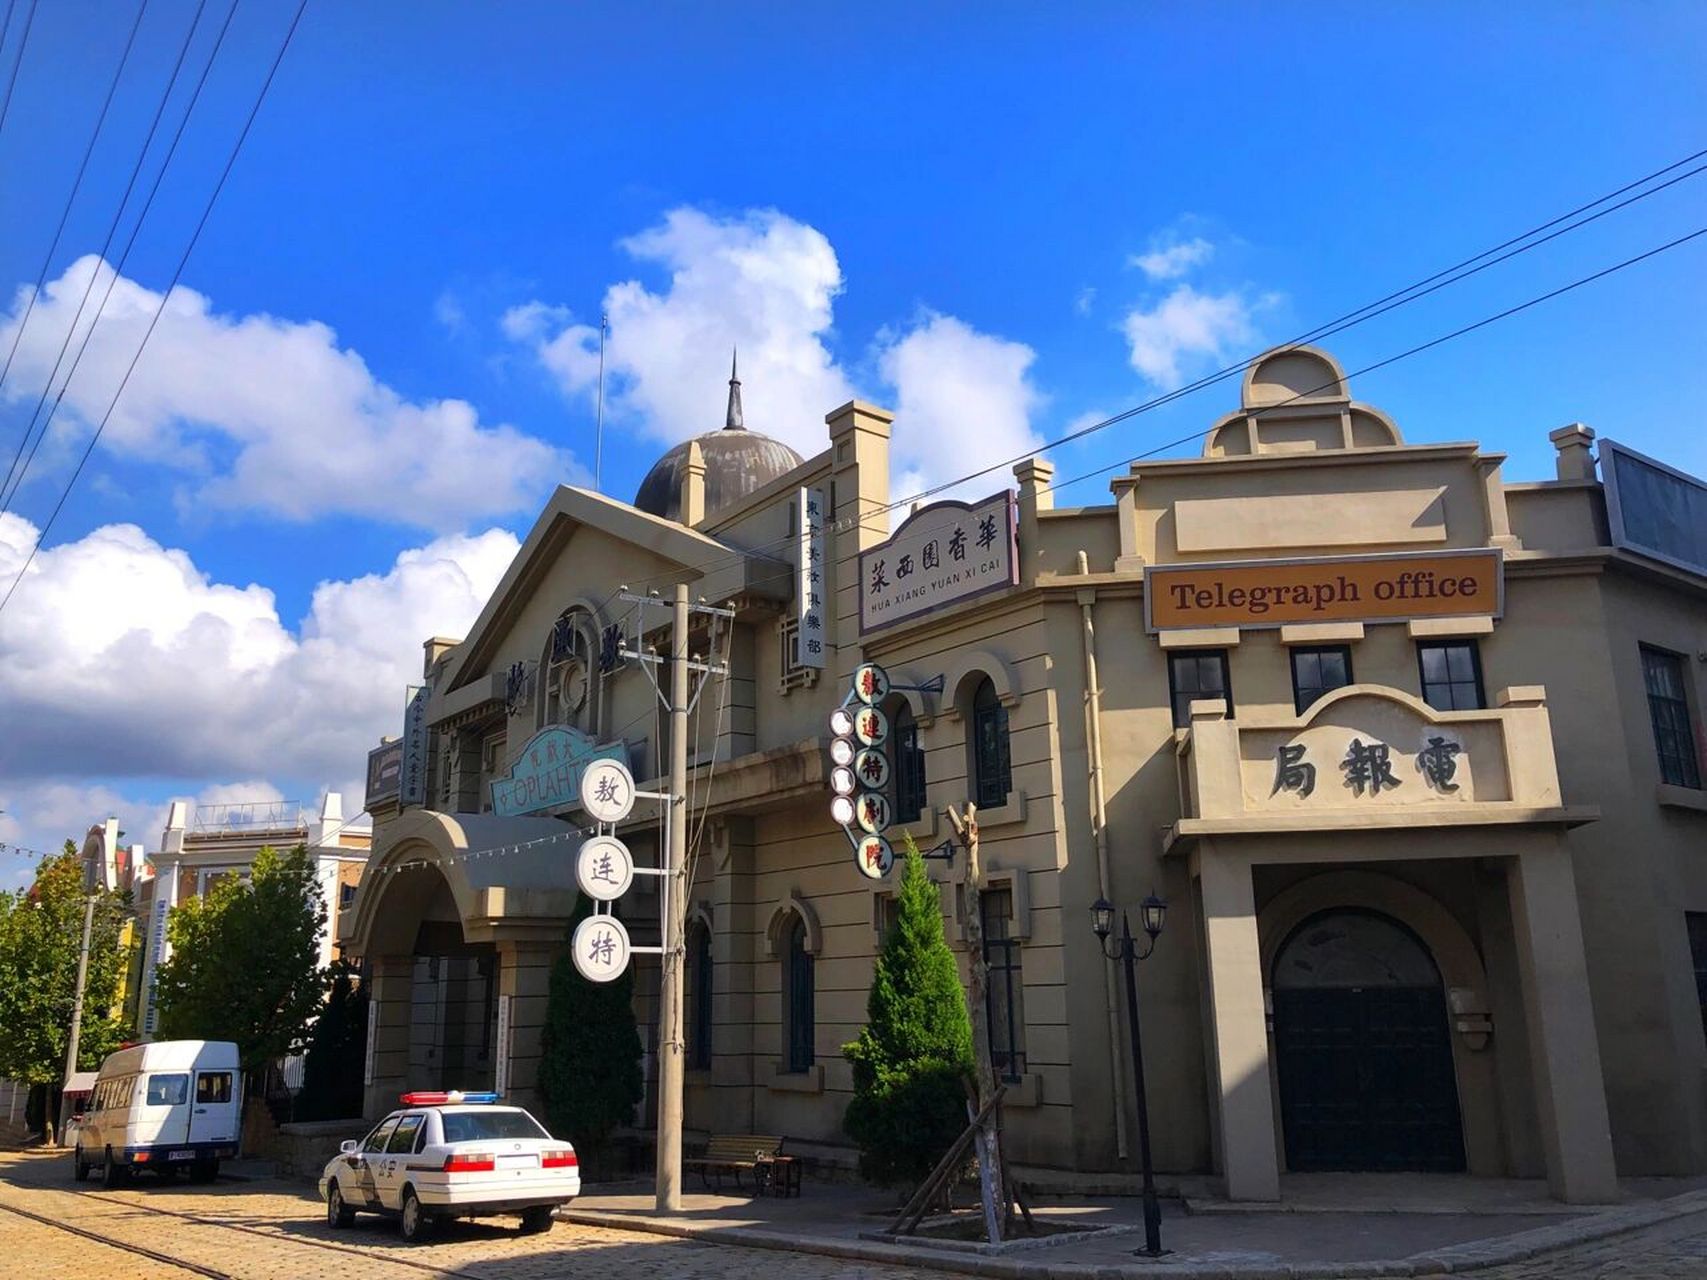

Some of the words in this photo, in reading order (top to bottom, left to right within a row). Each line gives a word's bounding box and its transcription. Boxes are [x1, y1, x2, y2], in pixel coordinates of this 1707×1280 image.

[871, 599, 891, 614] HUA
[894, 586, 927, 604] XIANG
[930, 573, 961, 592] YUAN
[964, 567, 977, 580] XI
[980, 558, 1001, 574] CAI
[1170, 575, 1361, 615] Telegraph
[1374, 571, 1478, 601] office
[588, 775, 622, 966] 敖连特
